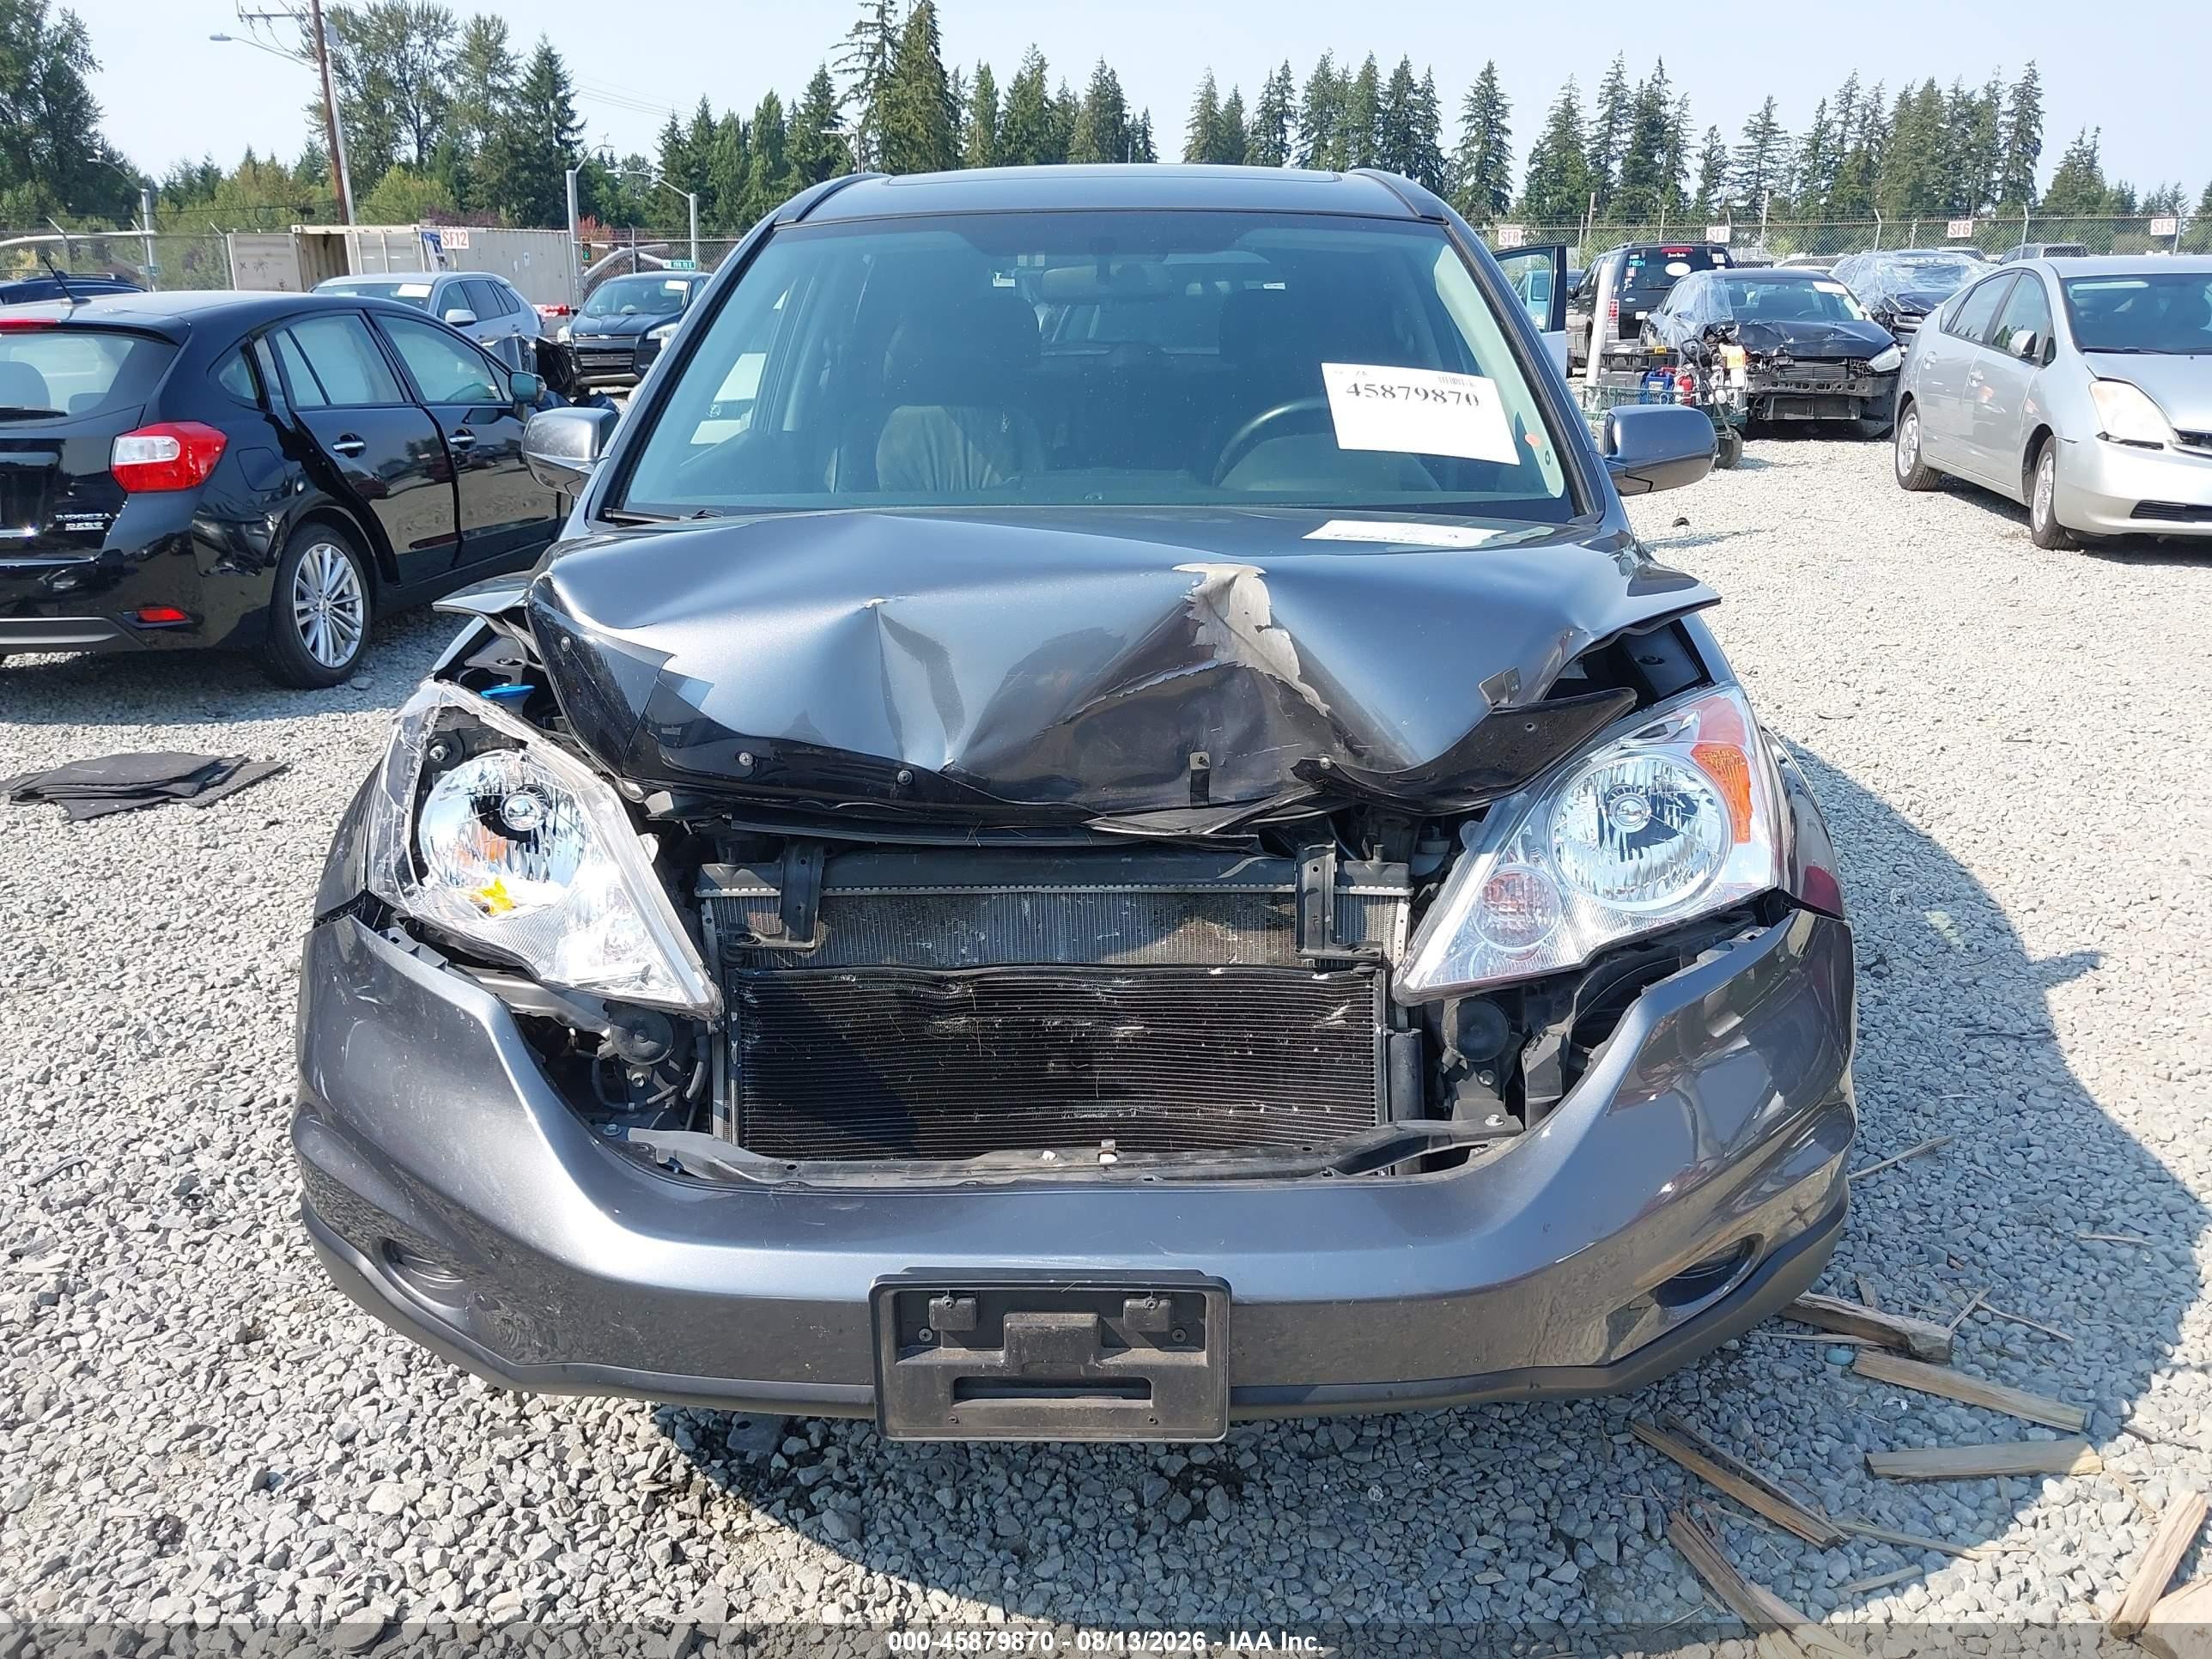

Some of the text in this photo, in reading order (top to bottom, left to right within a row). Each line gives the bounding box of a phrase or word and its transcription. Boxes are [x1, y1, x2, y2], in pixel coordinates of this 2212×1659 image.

[1949, 222, 1971, 236] SF6
[2153, 220, 2173, 234] SF5
[441, 230, 468, 246] SF12
[1709, 228, 1727, 241] SF7
[1346, 382, 1480, 407] 45879870
[55, 512, 113, 522] IMPREZA
